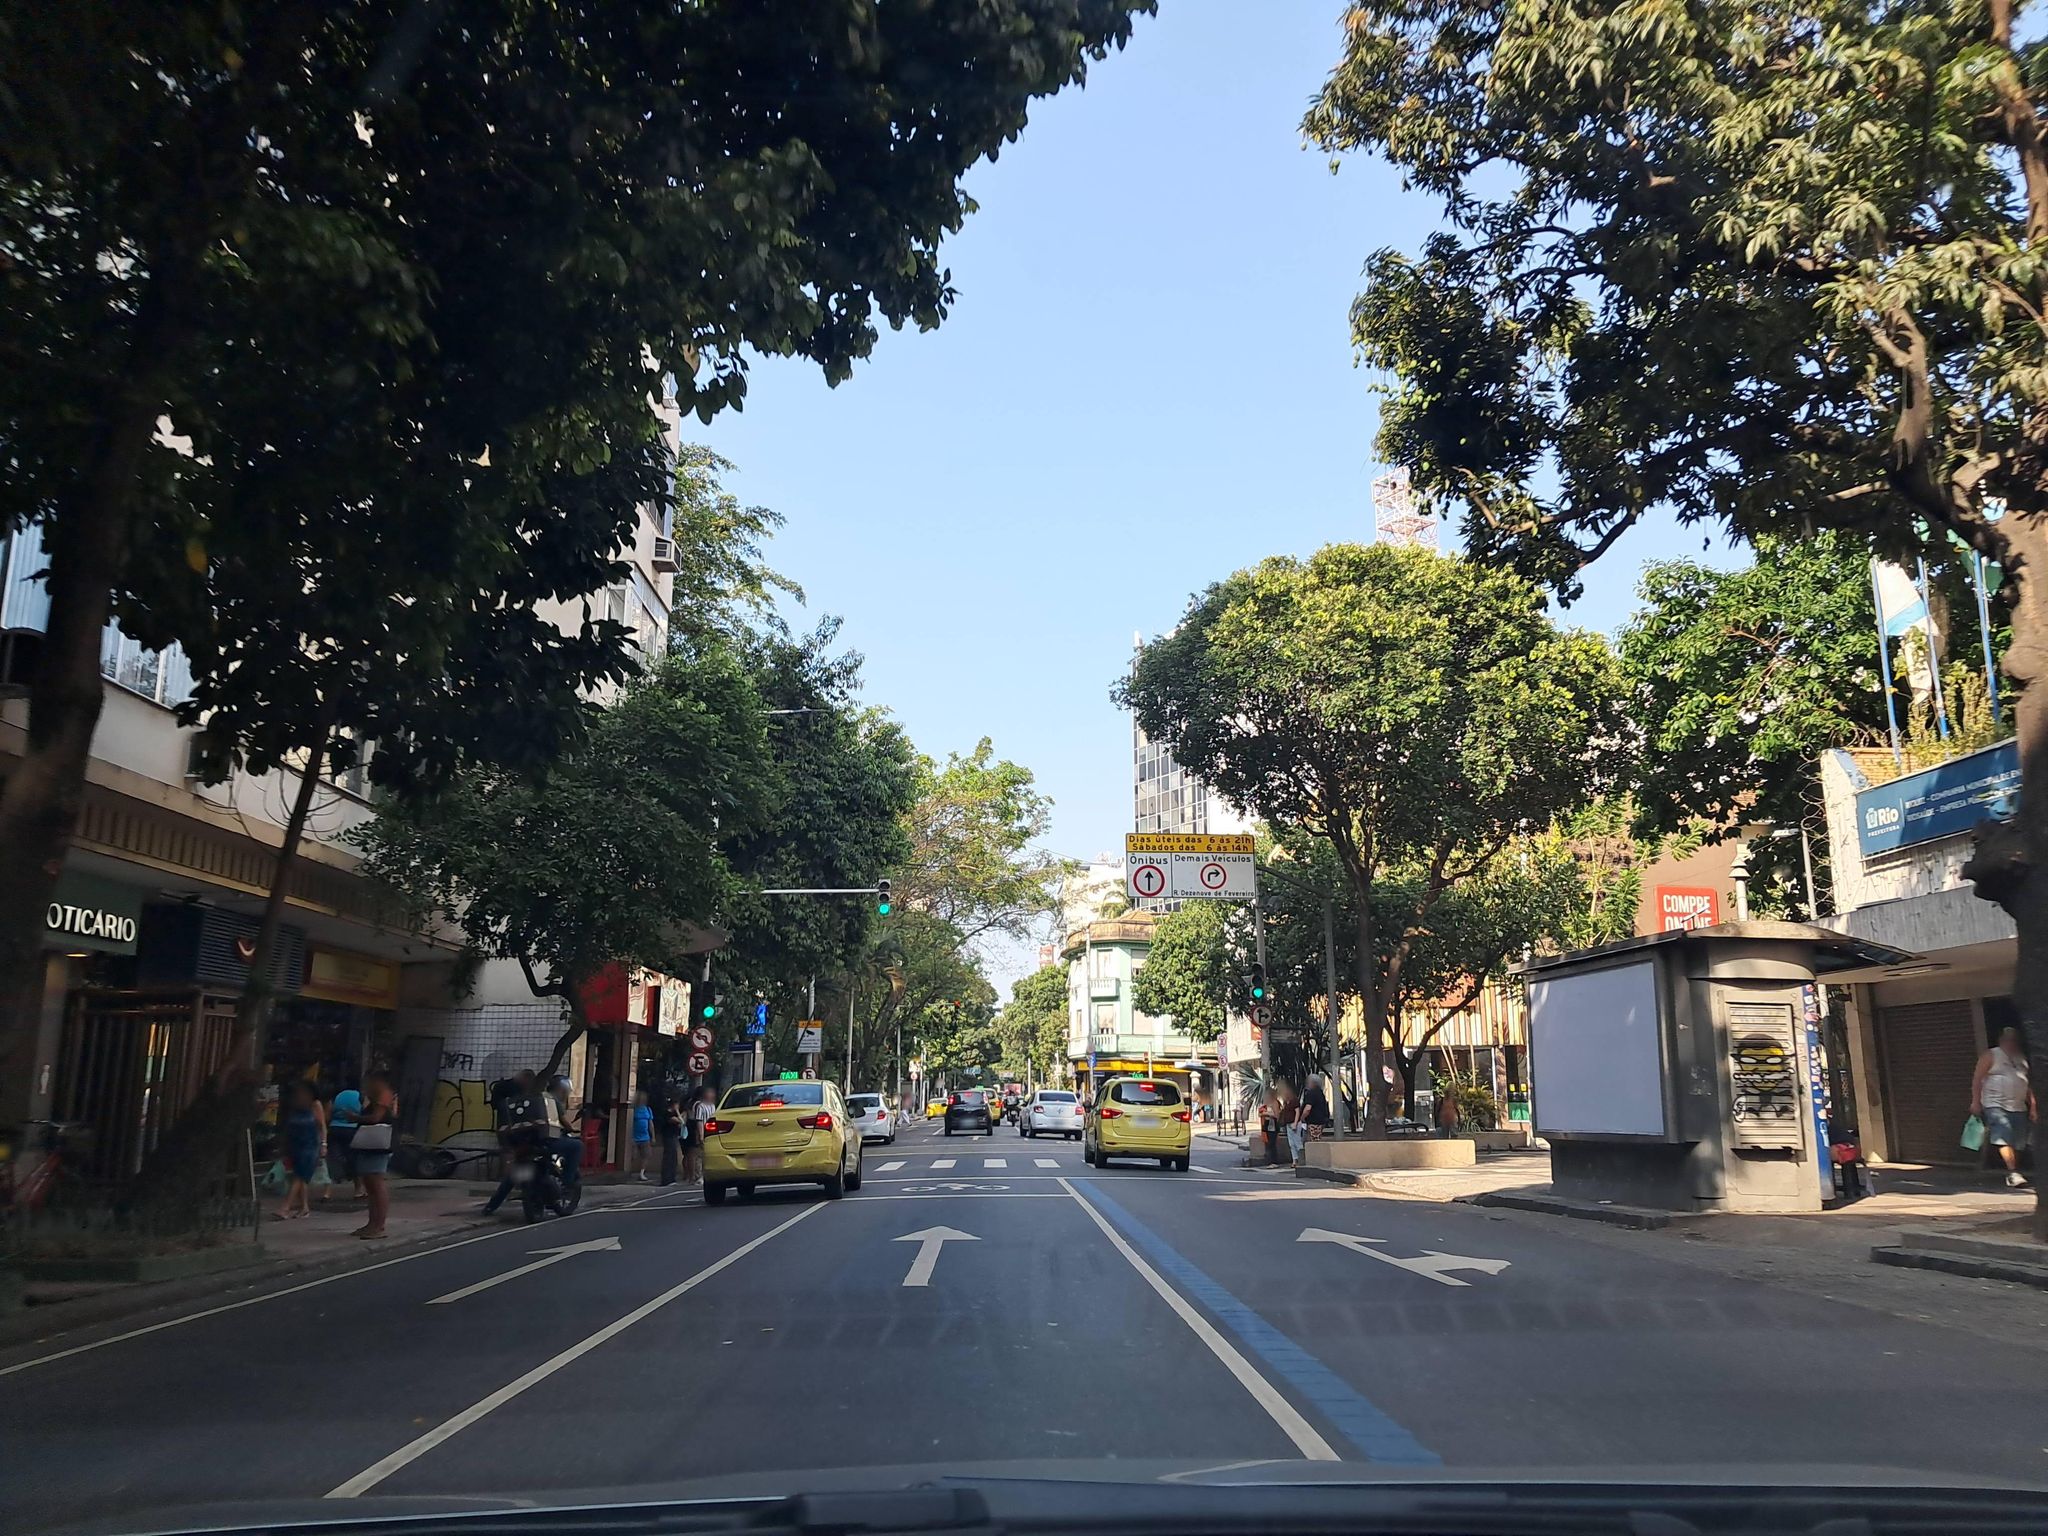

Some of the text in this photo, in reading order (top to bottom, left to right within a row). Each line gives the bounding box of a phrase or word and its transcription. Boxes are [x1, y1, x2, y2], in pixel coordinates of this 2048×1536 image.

[1878, 806, 1899, 826] Rio
[1867, 825, 1900, 838] PREFEITURA
[1155, 834, 1181, 843] úteis
[1132, 843, 1175, 851] Sábados
[1206, 844, 1213, 852] 6
[1231, 844, 1249, 852] 14h
[1130, 853, 1169, 865] Ônibus
[1174, 853, 1251, 863] Demais Veículos
[1663, 894, 1711, 914] COMPRE
[781, 1071, 799, 1080] TAXI
